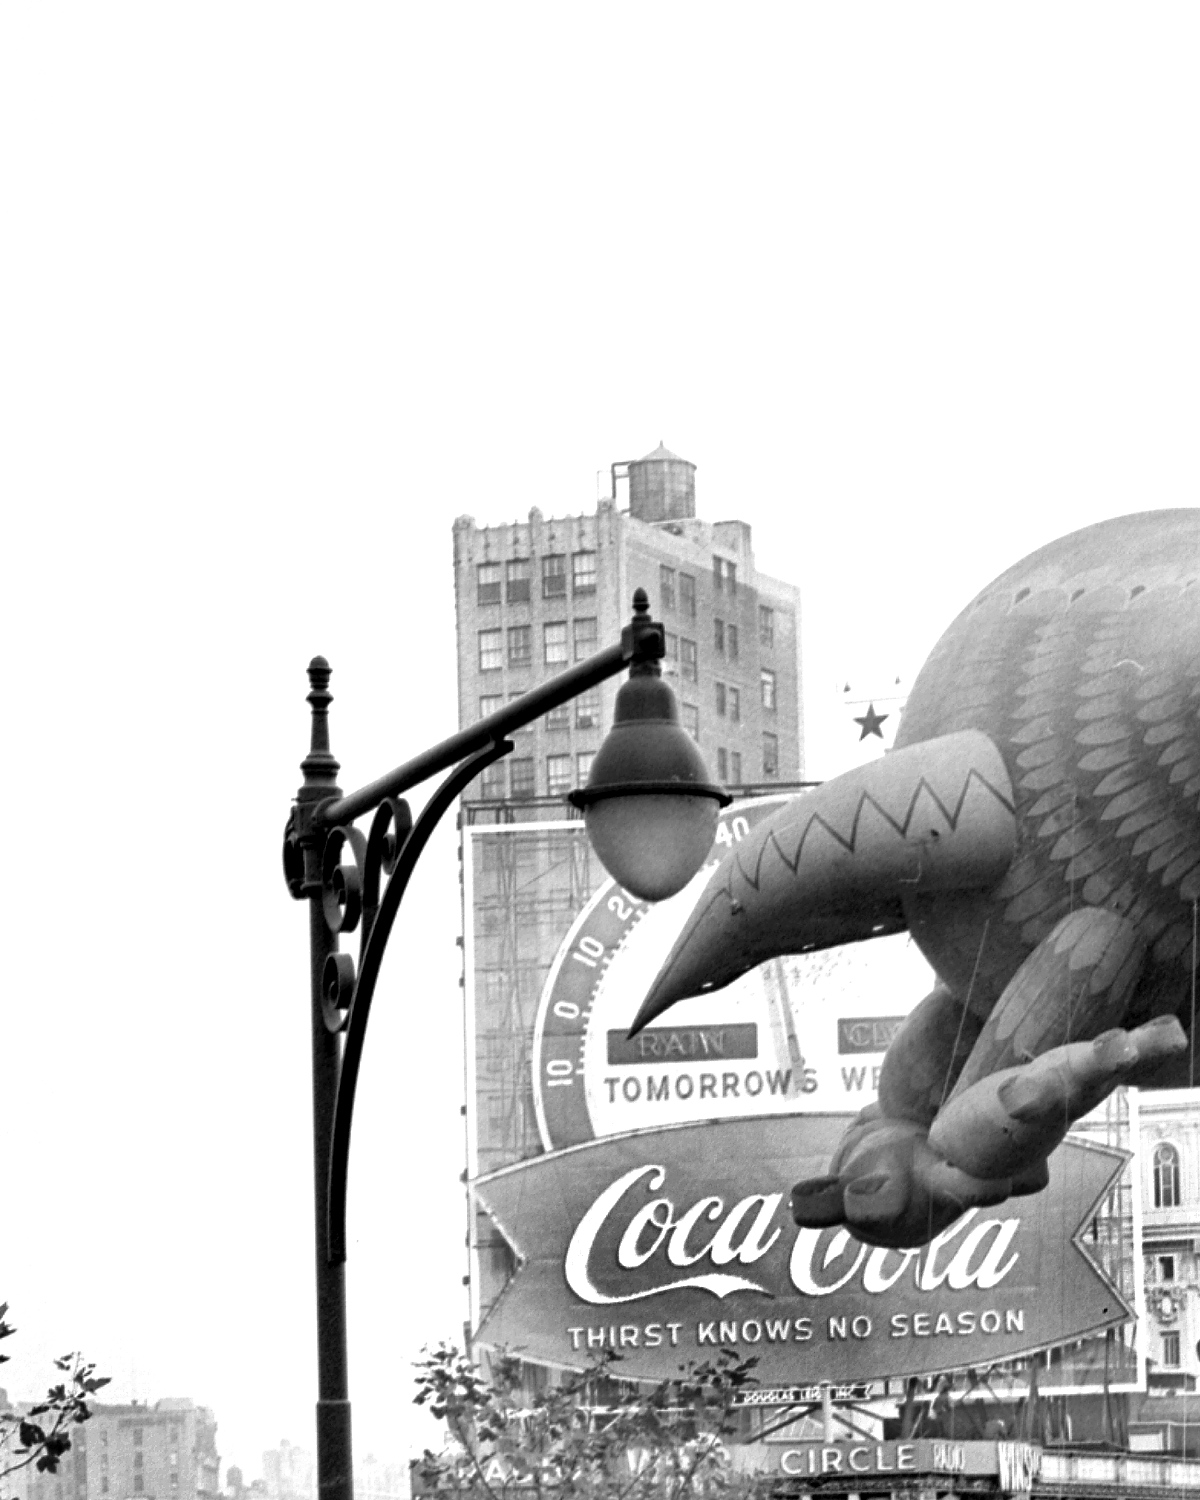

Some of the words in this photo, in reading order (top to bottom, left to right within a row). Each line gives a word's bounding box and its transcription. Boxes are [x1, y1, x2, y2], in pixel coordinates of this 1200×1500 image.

[715, 816, 749, 847] 40
[572, 935, 604, 967] 10
[553, 1001, 580, 1019] 0
[546, 1059, 573, 1087] 10
[567, 1324, 683, 1351] THIRST
[698, 1318, 813, 1345] KNOWS
[829, 1315, 873, 1340] NO
[891, 1309, 1026, 1338] SEASON
[780, 1445, 917, 1475] CIRCLE
